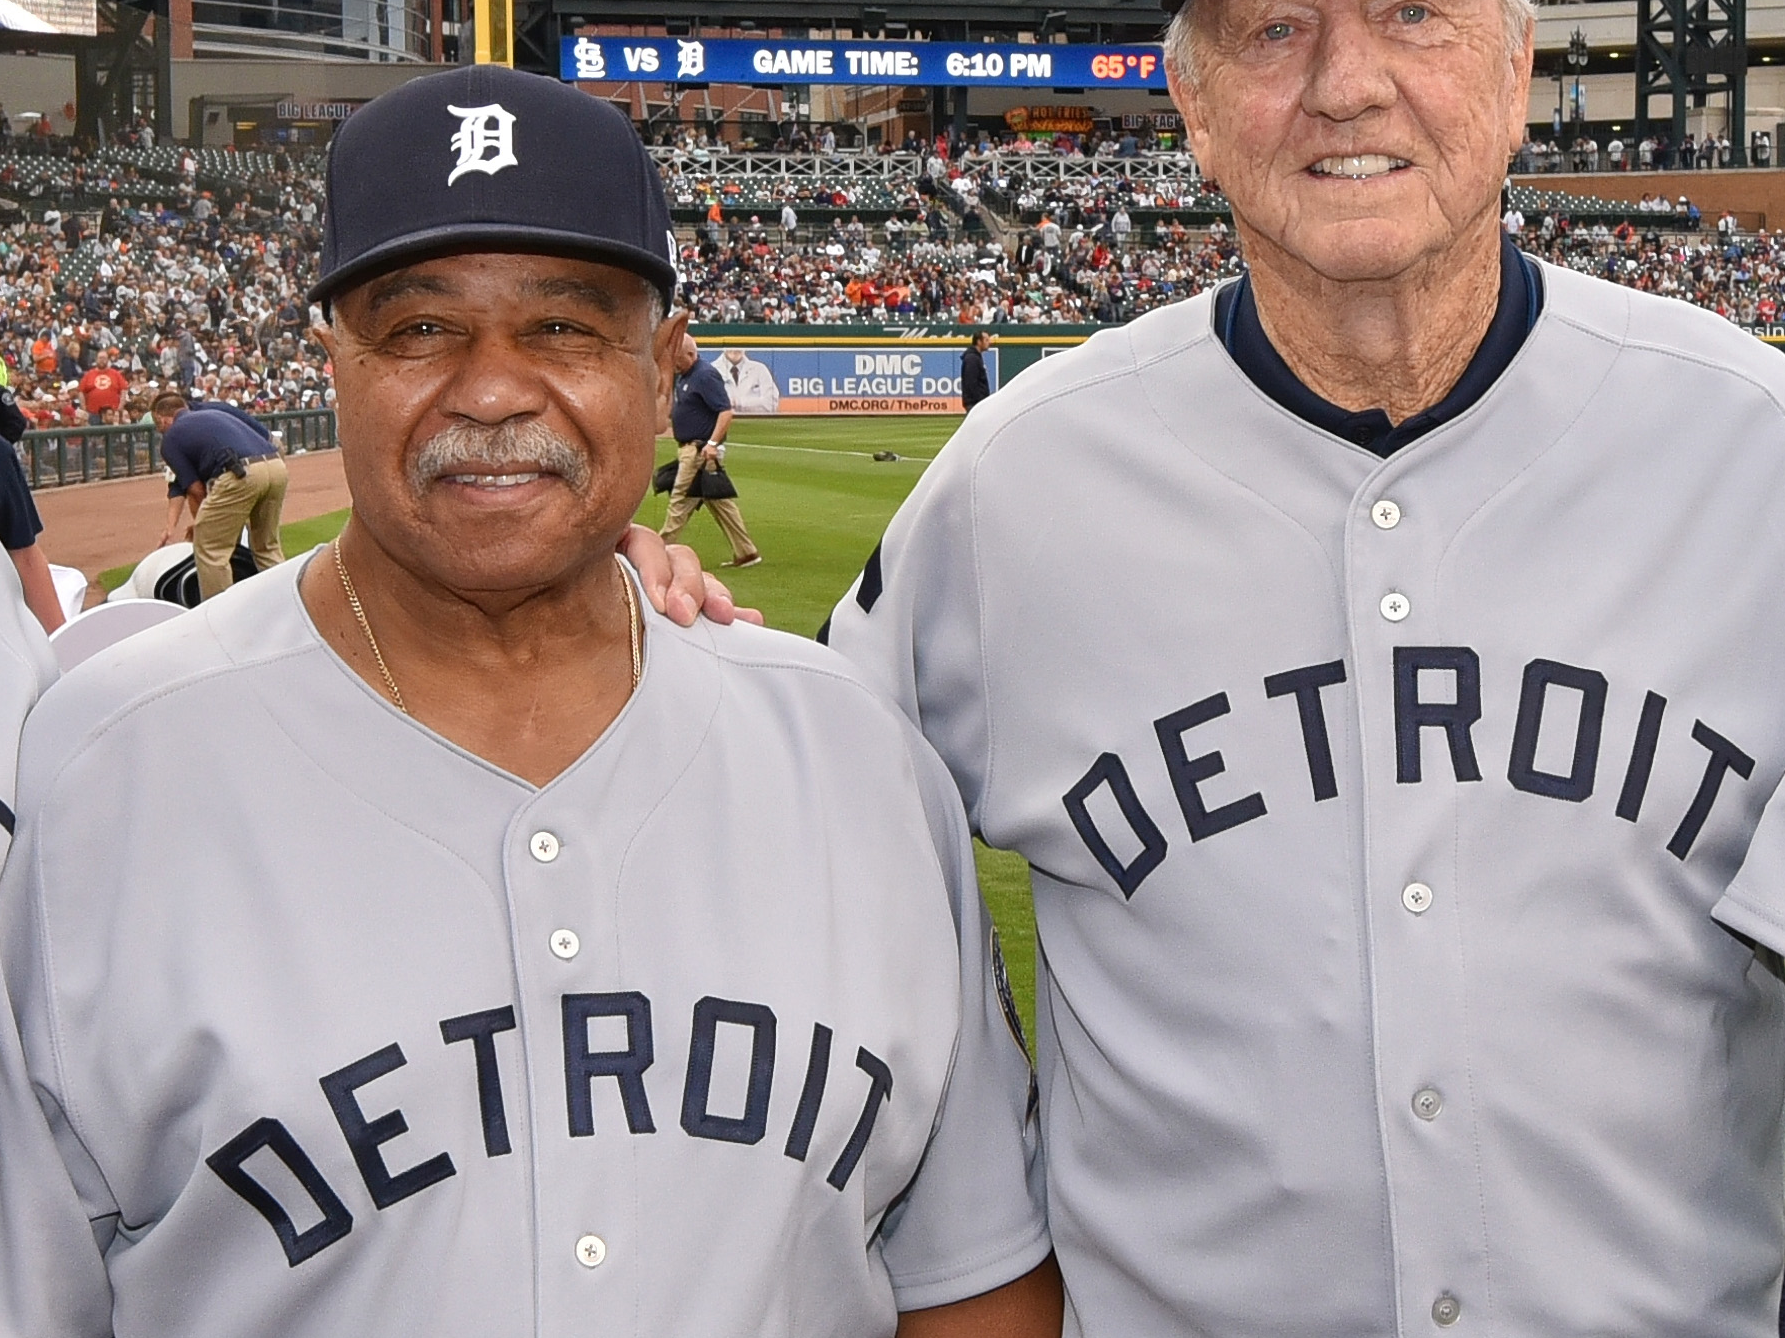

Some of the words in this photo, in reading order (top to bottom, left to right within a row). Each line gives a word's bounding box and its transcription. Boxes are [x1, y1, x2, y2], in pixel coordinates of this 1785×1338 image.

[623, 47, 660, 72] VS
[677, 39, 705, 79] D
[753, 49, 834, 75] GAME
[845, 50, 918, 75] TIME:
[946, 52, 1003, 77] 6:10
[1010, 53, 1052, 78] PM
[1091, 55, 1157, 79] 65°F
[277, 102, 301, 119] BIG
[447, 103, 519, 187] D
[855, 354, 922, 375] DMC
[788, 377, 824, 396] BIG
[831, 377, 914, 396] LEAGUE
[1062, 645, 1756, 900] DETROIT
[207, 990, 893, 1267] DETROIT
